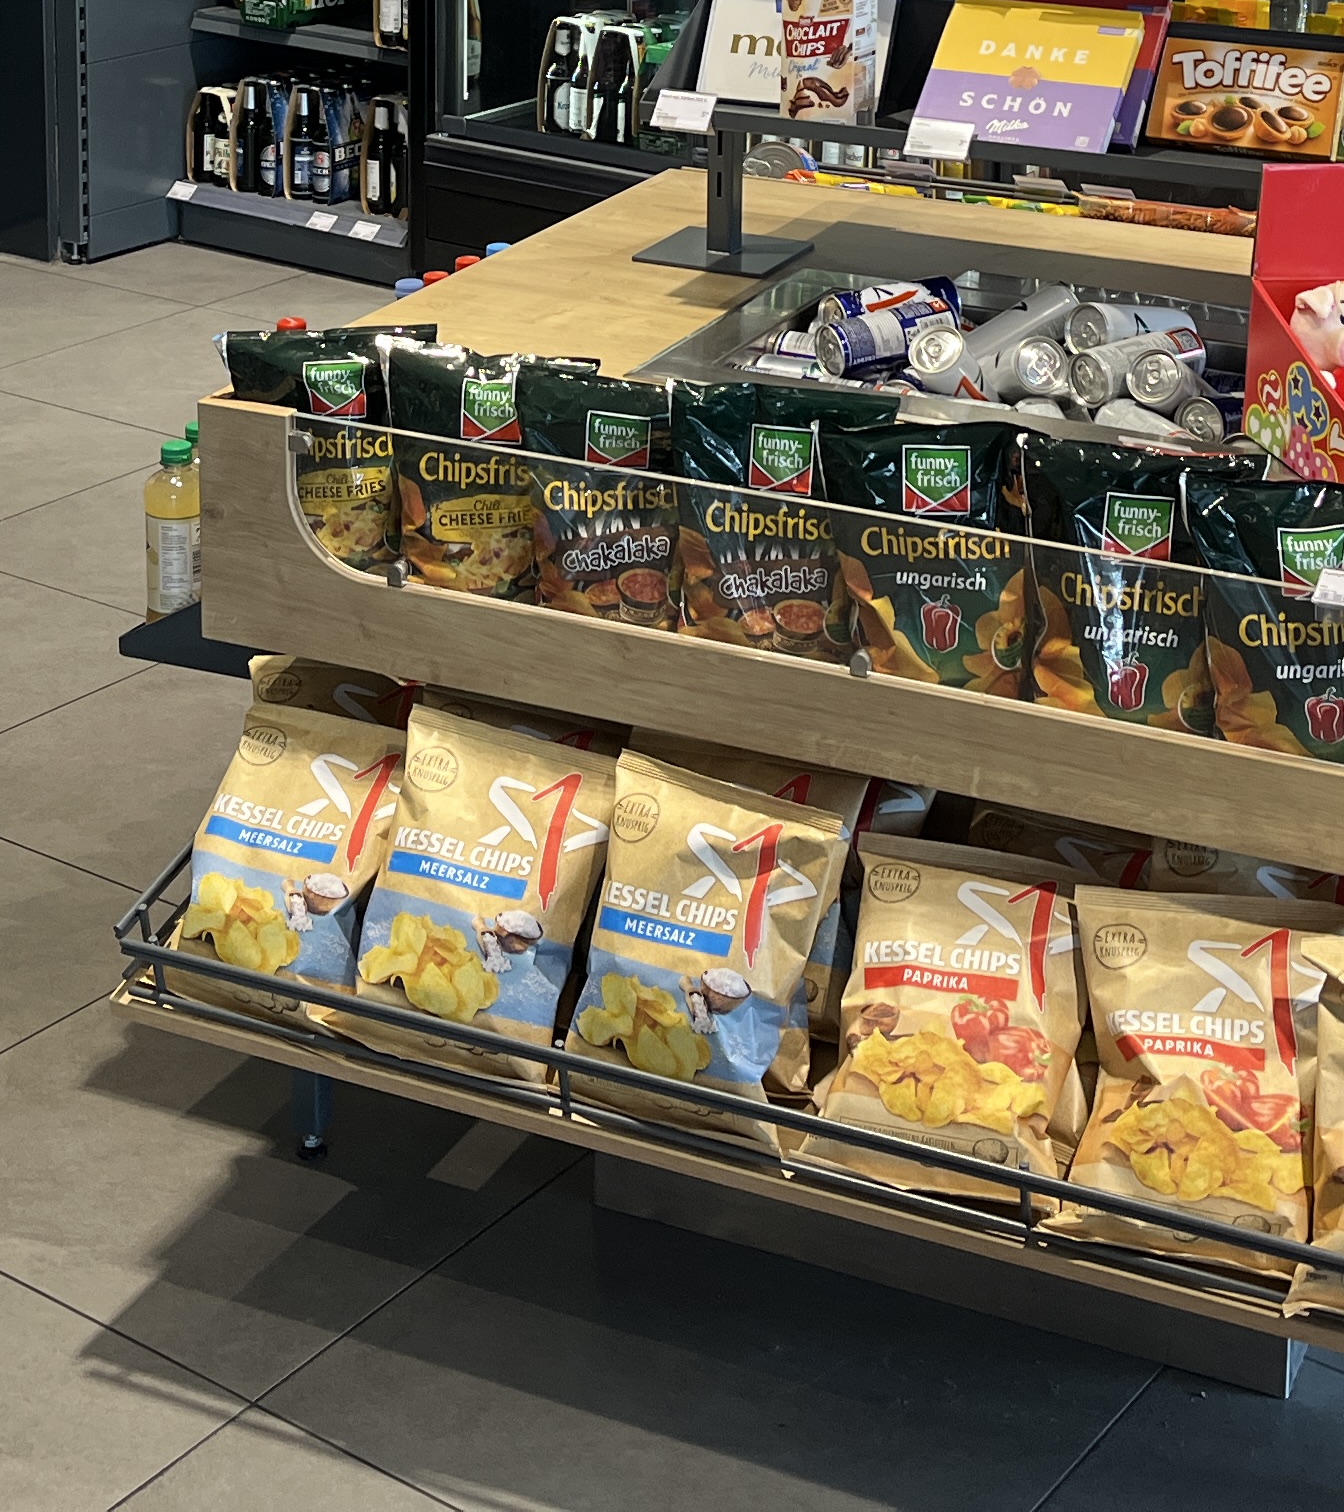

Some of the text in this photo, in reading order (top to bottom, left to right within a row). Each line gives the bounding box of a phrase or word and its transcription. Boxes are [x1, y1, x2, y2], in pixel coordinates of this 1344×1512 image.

[786, 21, 841, 42] CHOCLAIT
[792, 40, 825, 57] CHIPS
[978, 40, 1091, 65] DANKE
[1171, 49, 1333, 103] Toffifee
[959, 91, 1073, 118] SCHÖN
[986, 117, 1030, 134] Milka
[335, 142, 362, 163] BEC
[594, 420, 639, 441] funny-
[600, 433, 640, 452] frisch
[758, 432, 804, 454] funny-
[420, 452, 530, 489] Chipsfris
[762, 449, 804, 469] frisch
[909, 452, 959, 477] funny-
[916, 469, 961, 489] frisch
[439, 510, 532, 528] CHEESE FRIE
[1113, 502, 1164, 526] funny-
[1118, 518, 1163, 539] frisch
[563, 535, 670, 574] Chakalaka
[860, 527, 1010, 561] Chipsfrisch
[719, 564, 829, 599] Chakalaka
[895, 572, 987, 592] ungarisch
[1084, 624, 1179, 649] ungarisch
[420, 753, 449, 770] EXTRA
[215, 792, 344, 844] KESSEL CHIPS
[238, 828, 303, 855] MEERSALZ
[394, 825, 533, 877] KESSEL CHIPS
[418, 858, 489, 890] MEERSALZ
[864, 939, 1021, 976] KESSEL CHIPS
[902, 968, 970, 991] PAPRIKA
